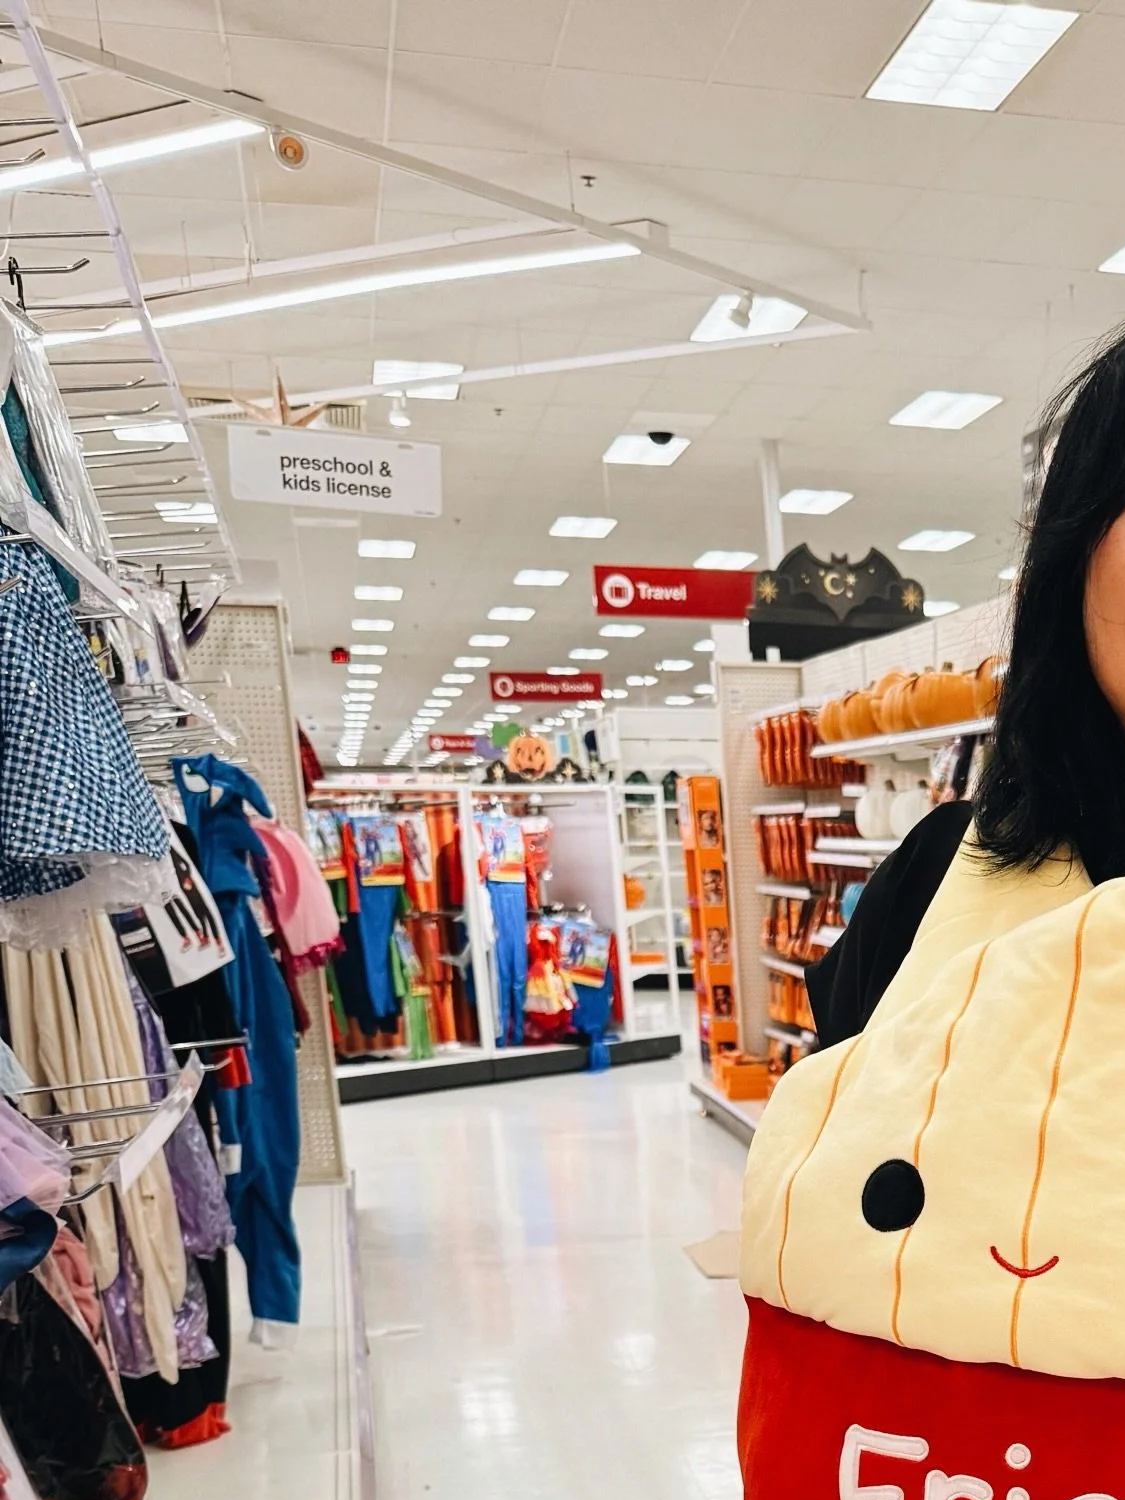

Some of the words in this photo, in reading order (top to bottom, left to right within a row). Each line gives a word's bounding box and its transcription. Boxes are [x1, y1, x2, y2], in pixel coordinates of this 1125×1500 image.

[280, 455, 374, 476] preschool
[379, 461, 393, 478] &
[282, 473, 321, 492] kids
[326, 477, 392, 499] license
[635, 581, 687, 602] Travel
[515, 682, 560, 695] Sporting
